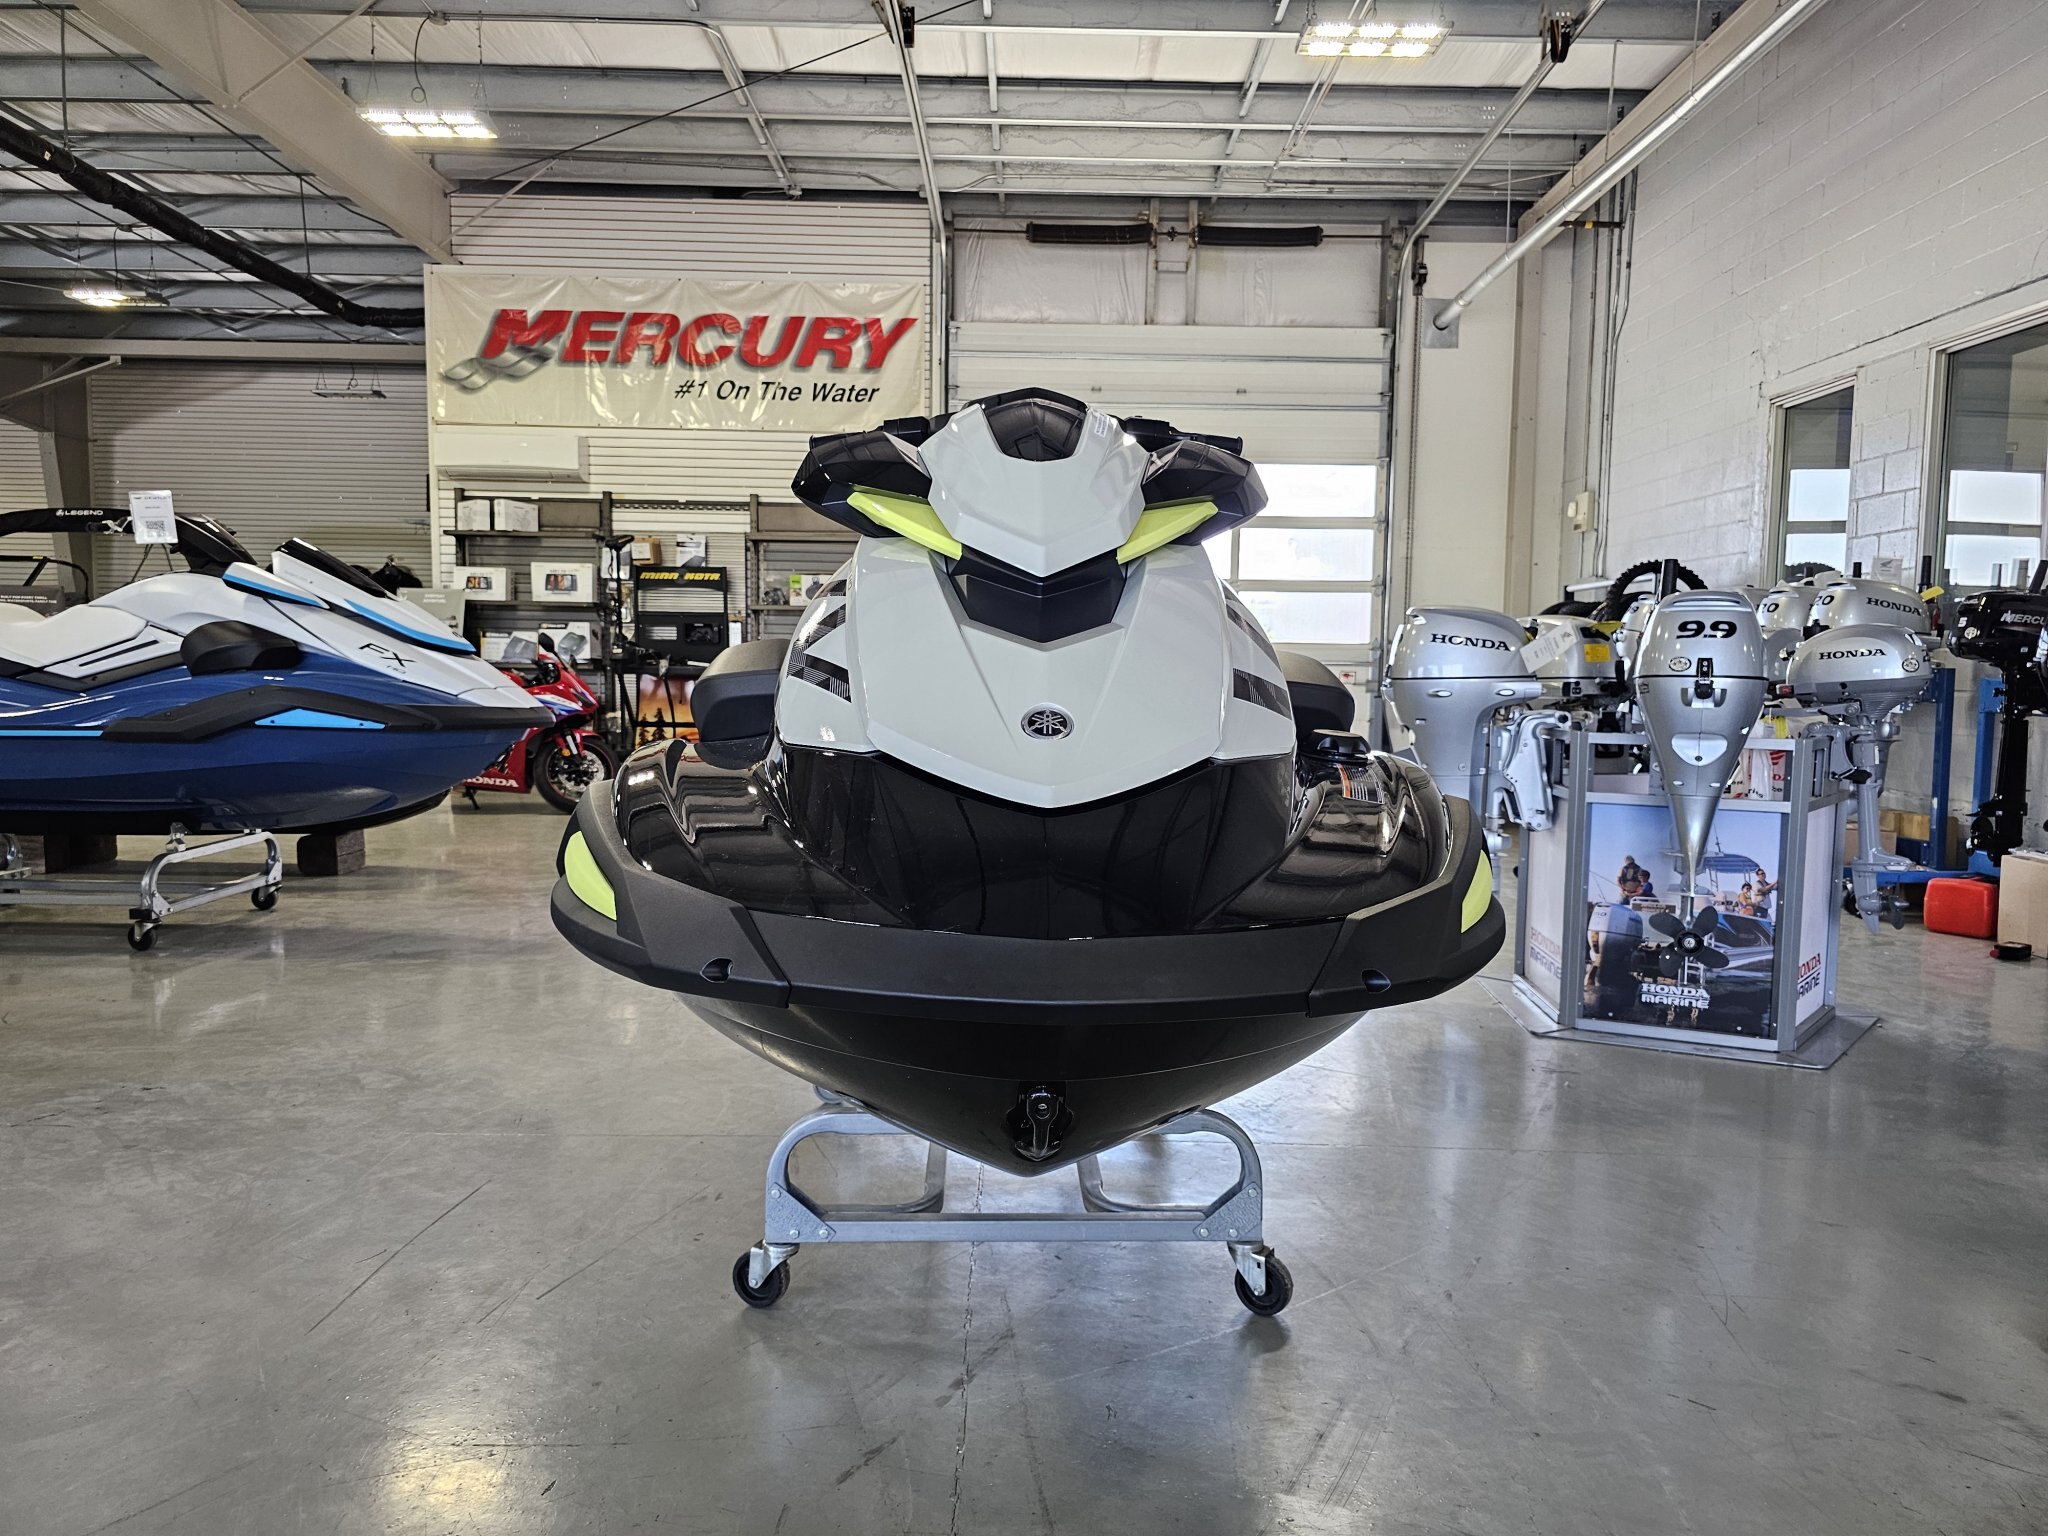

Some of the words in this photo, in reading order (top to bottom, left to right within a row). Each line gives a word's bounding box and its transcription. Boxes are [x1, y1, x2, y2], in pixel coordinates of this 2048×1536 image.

[481, 308, 918, 368] MERCURY
[674, 381, 706, 399] #1
[715, 381, 750, 401] On
[759, 381, 801, 402] The
[812, 382, 880, 403] Water
[683, 572, 721, 581] KOTA
[1866, 597, 1922, 616] HONDA
[1676, 620, 1738, 639] 9.9
[1430, 633, 1511, 651] HONDA
[358, 642, 416, 667] FX
[1818, 648, 1887, 661] HONDA
[1641, 983, 1710, 998] HONDA
[1797, 972, 1821, 998] ARINE
[1641, 994, 1710, 1010] MARINE
